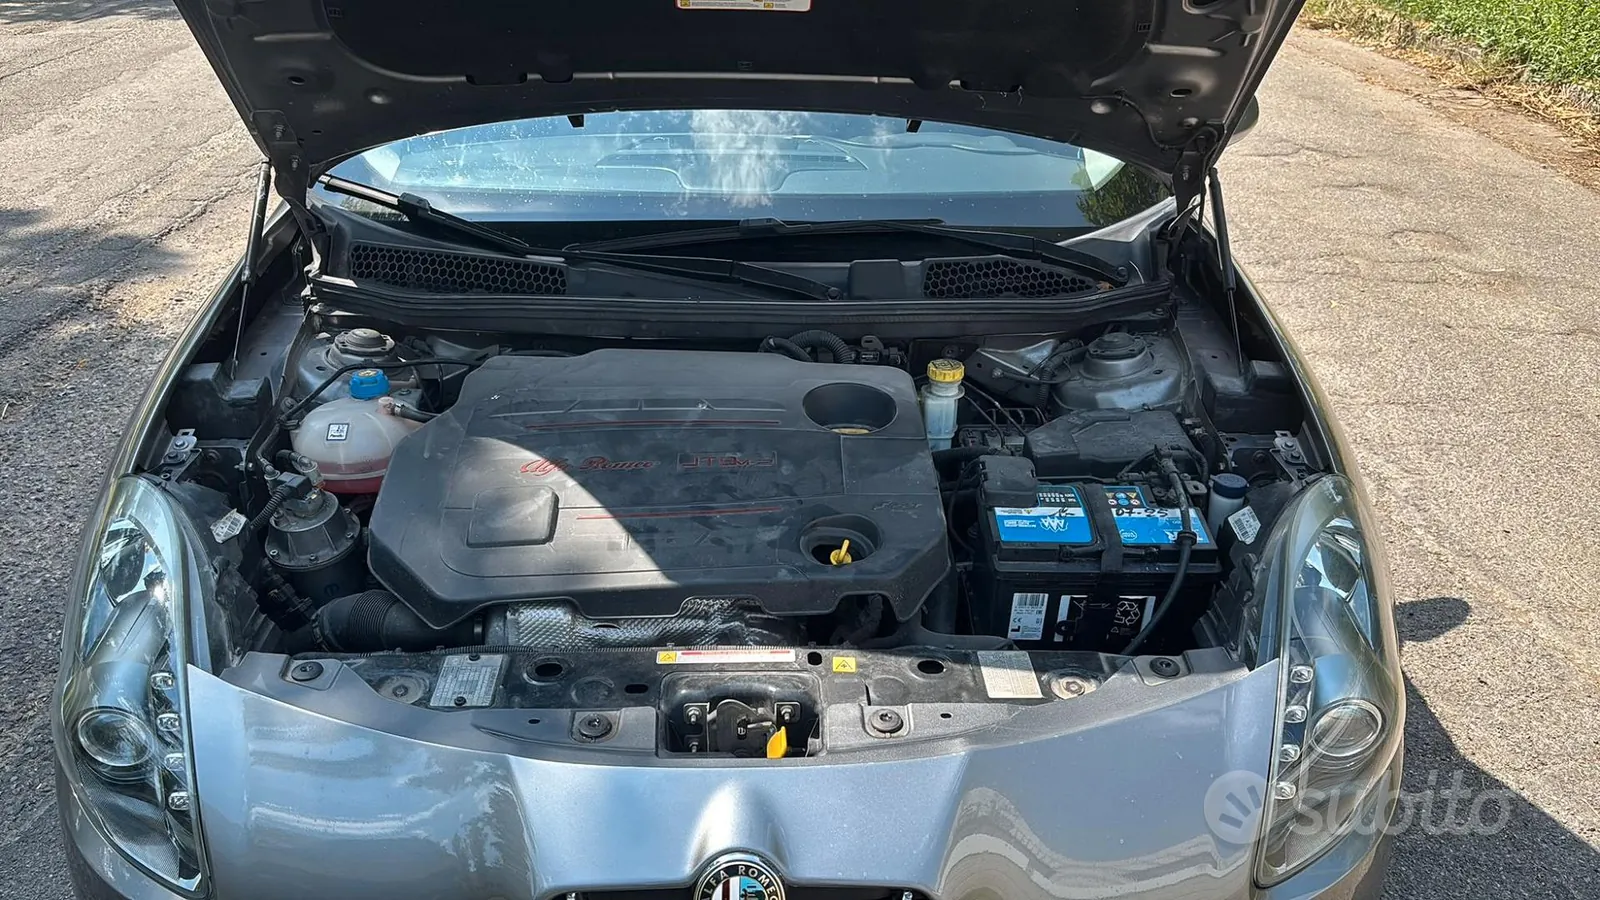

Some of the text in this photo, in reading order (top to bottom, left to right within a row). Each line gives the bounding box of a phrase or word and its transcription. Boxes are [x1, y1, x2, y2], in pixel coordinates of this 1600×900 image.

[519, 455, 656, 476] Alfa Romeo
[701, 870, 729, 900] LFA
